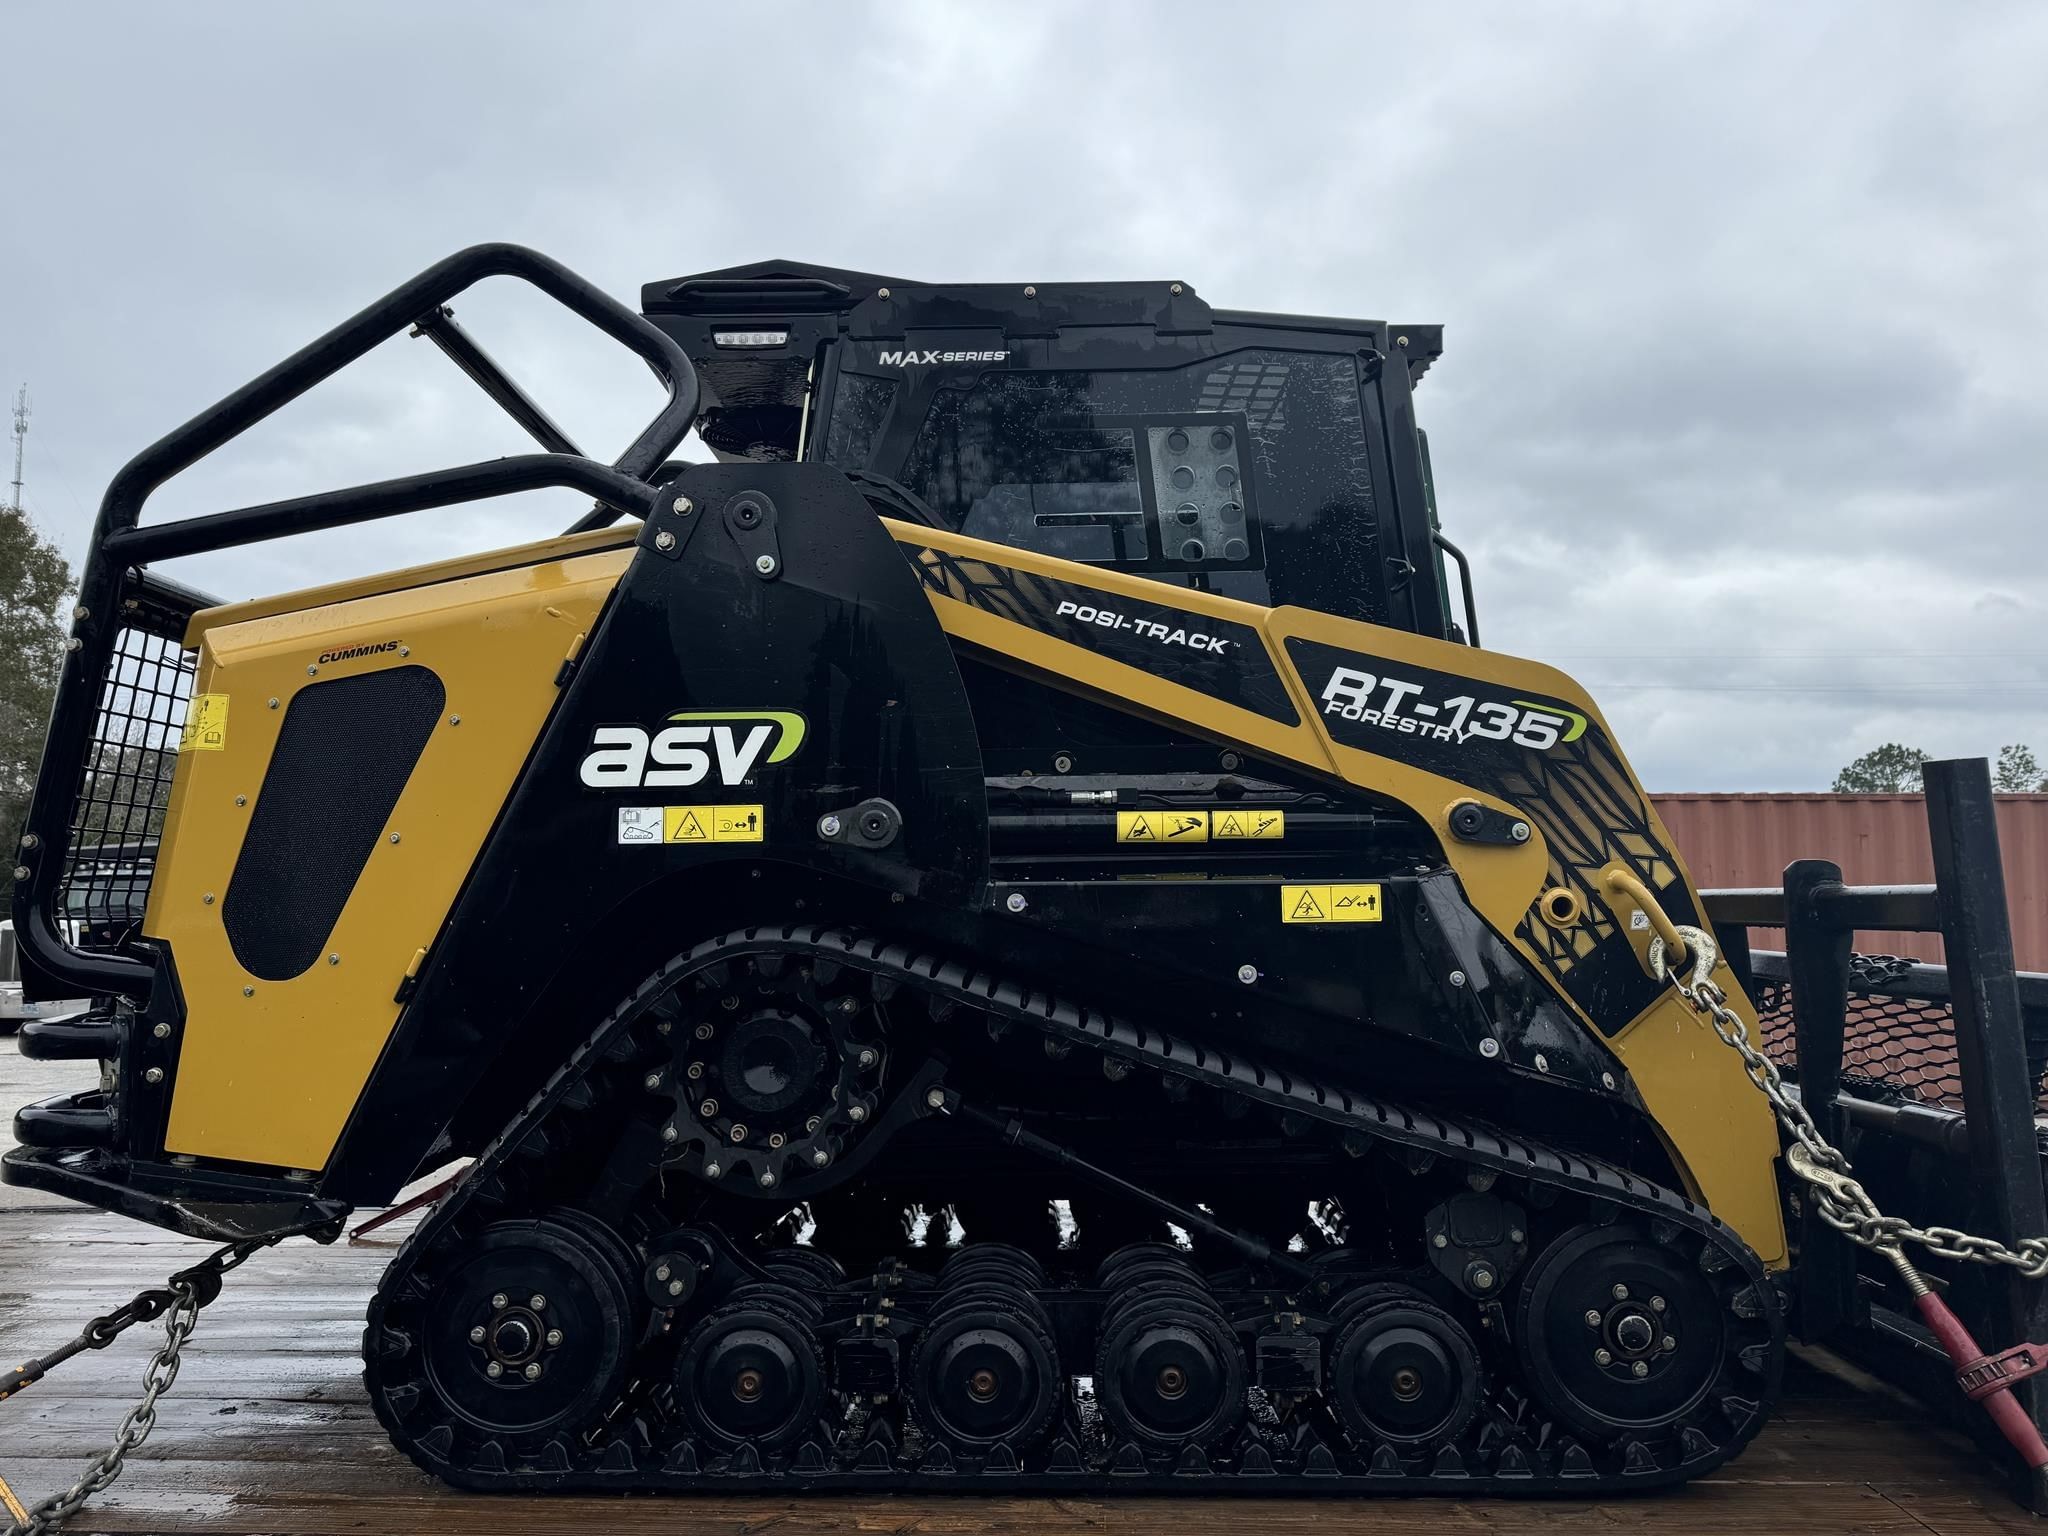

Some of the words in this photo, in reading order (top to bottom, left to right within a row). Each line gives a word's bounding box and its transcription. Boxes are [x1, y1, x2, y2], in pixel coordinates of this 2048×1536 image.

[879, 350, 1005, 367] MAX-SERIES
[1055, 600, 1230, 655] POSI-TRACK
[318, 640, 398, 664] CUMMINS
[1321, 666, 1565, 750] RT-135
[1324, 700, 1475, 745] FORESTRY
